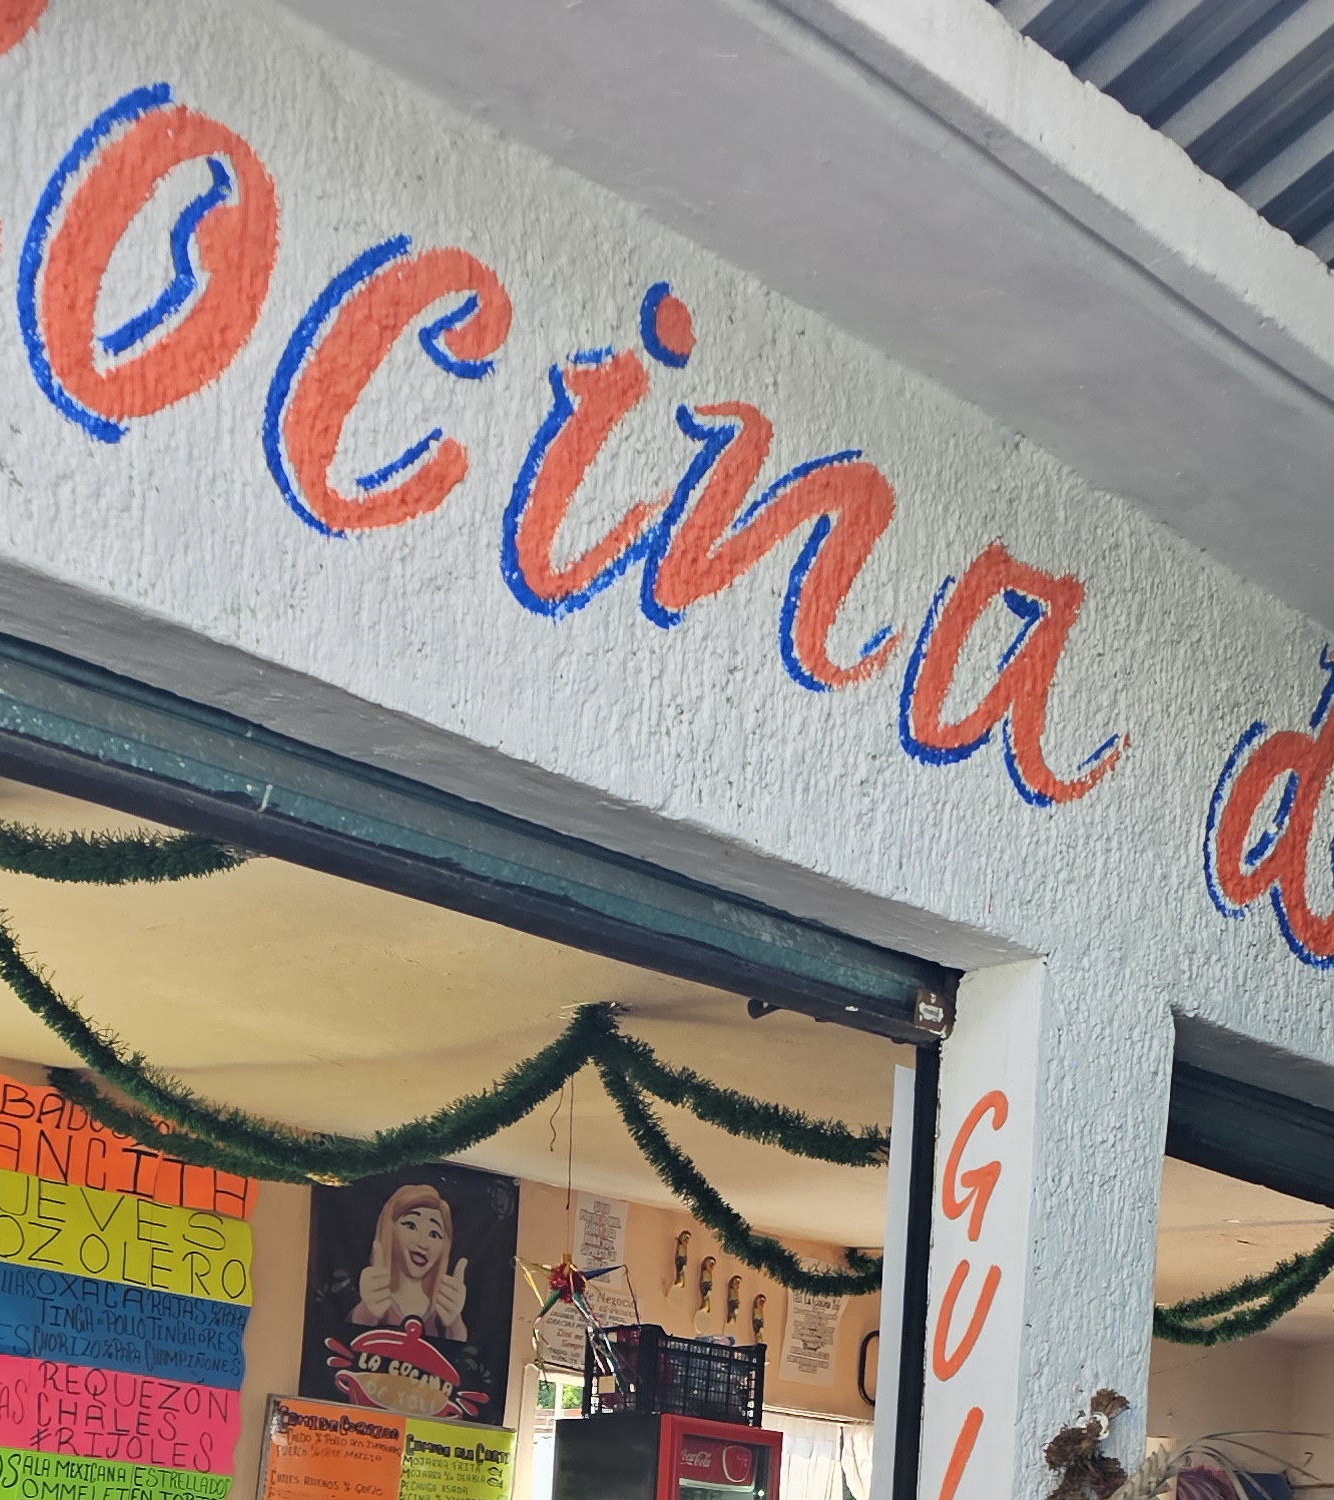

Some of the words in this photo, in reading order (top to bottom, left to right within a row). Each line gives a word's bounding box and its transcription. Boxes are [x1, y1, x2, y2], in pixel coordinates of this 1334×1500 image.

[36, 1296, 95, 1333] TINGA
[102, 1309, 147, 1340] POLLO
[147, 1316, 196, 1346] TINGA
[148, 1291, 207, 1326] RAJAS
[33, 1325, 101, 1359] CHORIZO
[144, 1340, 241, 1377] CHAMPIÑONES
[358, 1352, 381, 1371] LA
[388, 1361, 453, 1396] COCINA
[366, 1383, 387, 1400] DE
[36, 1392, 177, 1441] CHALES
[30, 1427, 214, 1474] FRIJOLES
[402, 1455, 448, 1469] MOJARRA
[55, 1460, 126, 1484] MEXICANA
[134, 1467, 230, 1500] ESTRELLADOS
[400, 1480, 437, 1493] PECHUGA
[401, 1468, 442, 1480] MOJARRA
[457, 1473, 486, 1484] DIABLA
